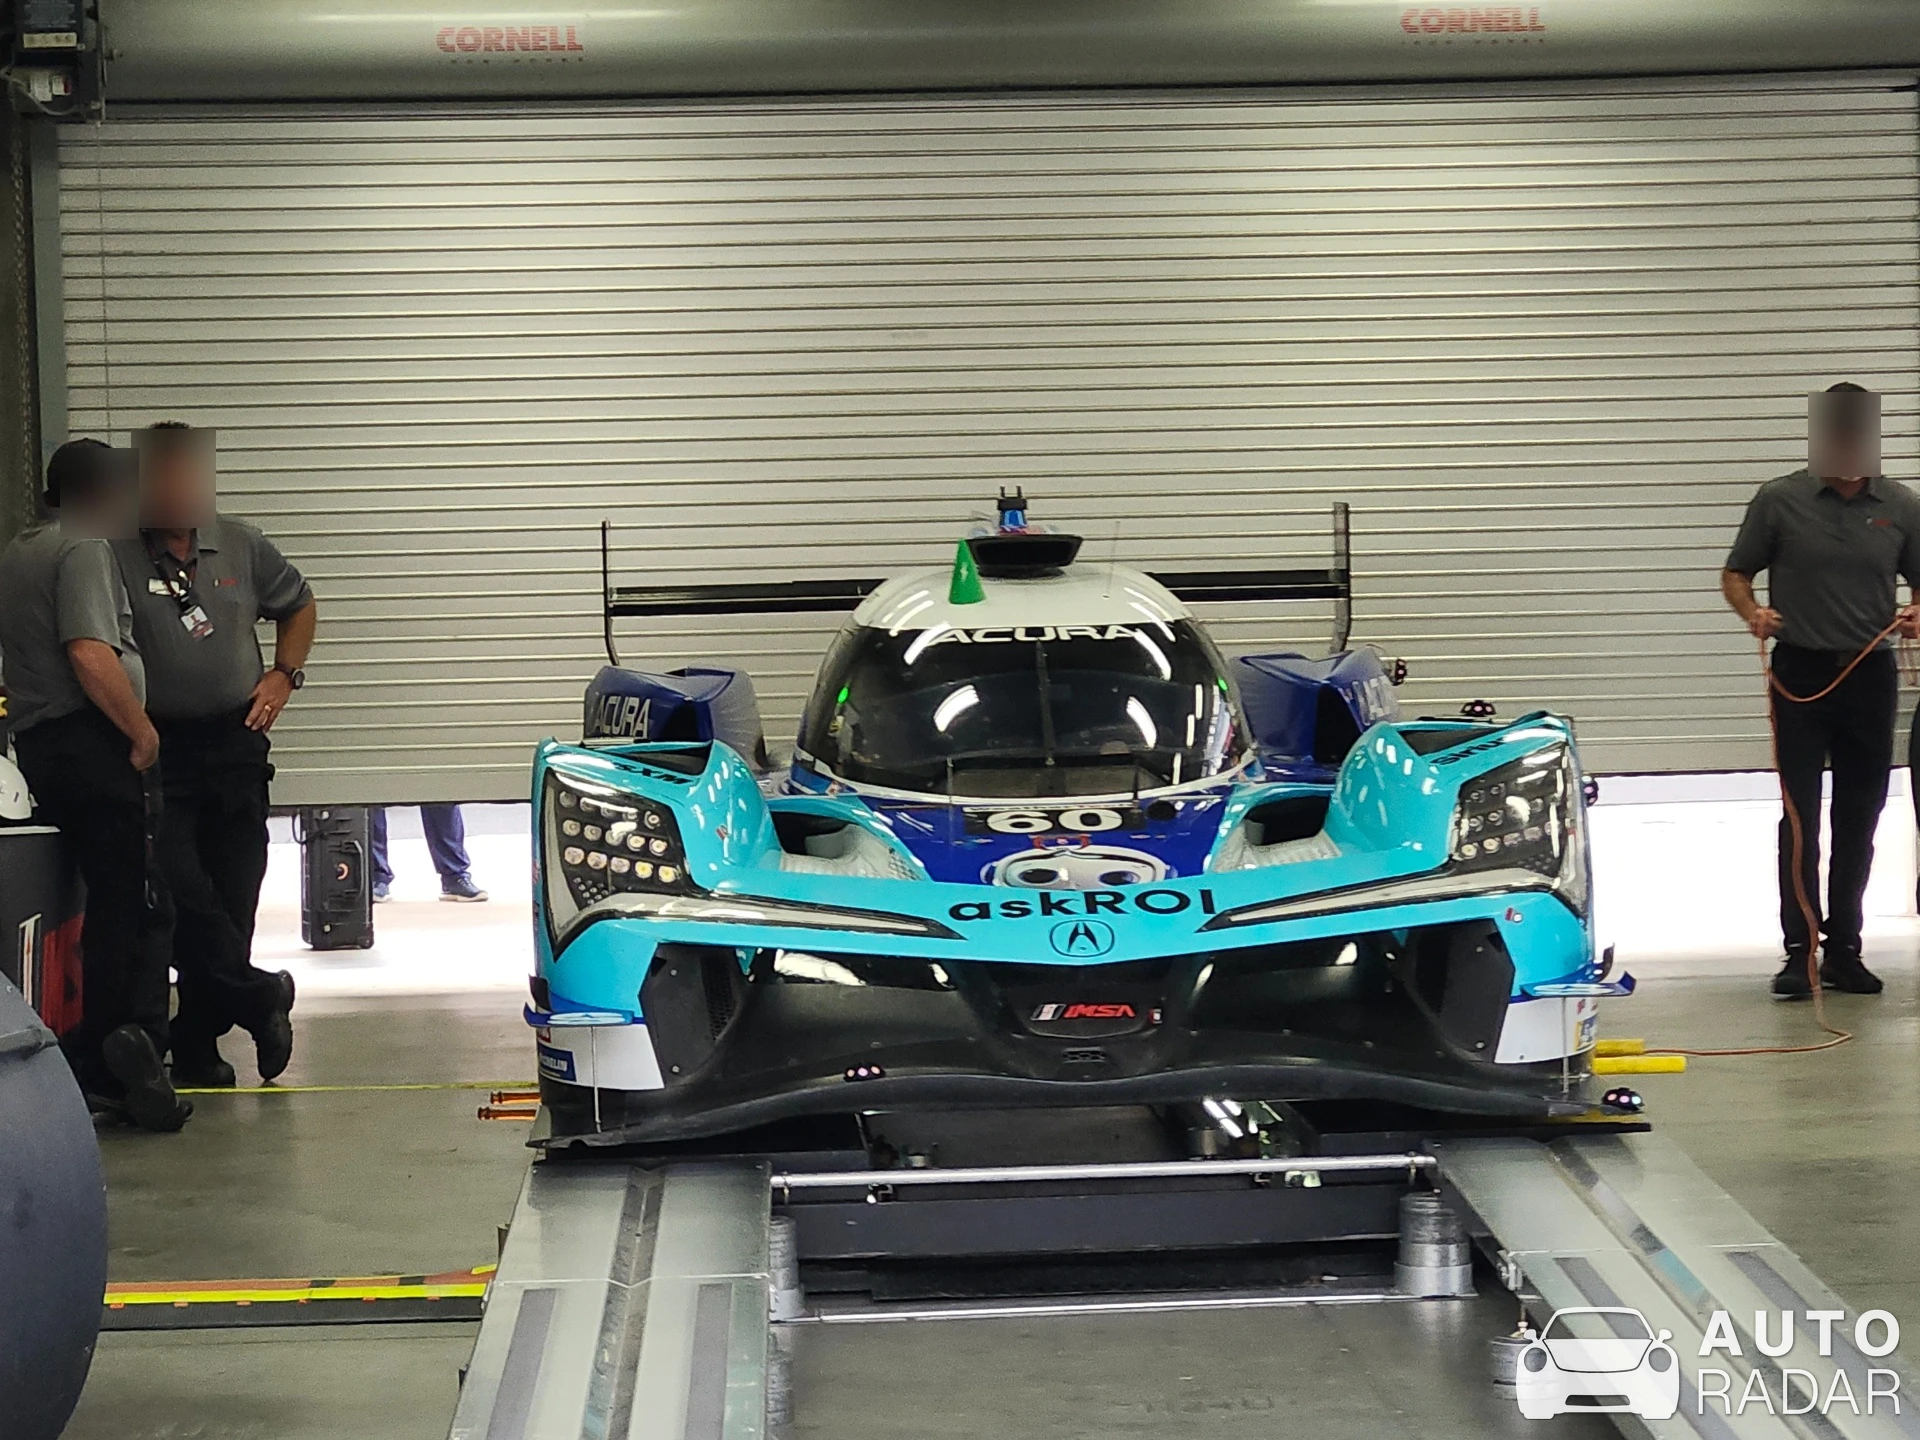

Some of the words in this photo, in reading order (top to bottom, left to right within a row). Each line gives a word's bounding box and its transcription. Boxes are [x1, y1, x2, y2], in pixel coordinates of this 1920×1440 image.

[1400, 7, 1546, 33] CORNELL
[436, 25, 584, 52] CORNELL
[925, 624, 1141, 647] ACURA
[593, 694, 651, 740] ACURA
[986, 808, 1123, 834] 60
[948, 888, 1218, 921] askROI
